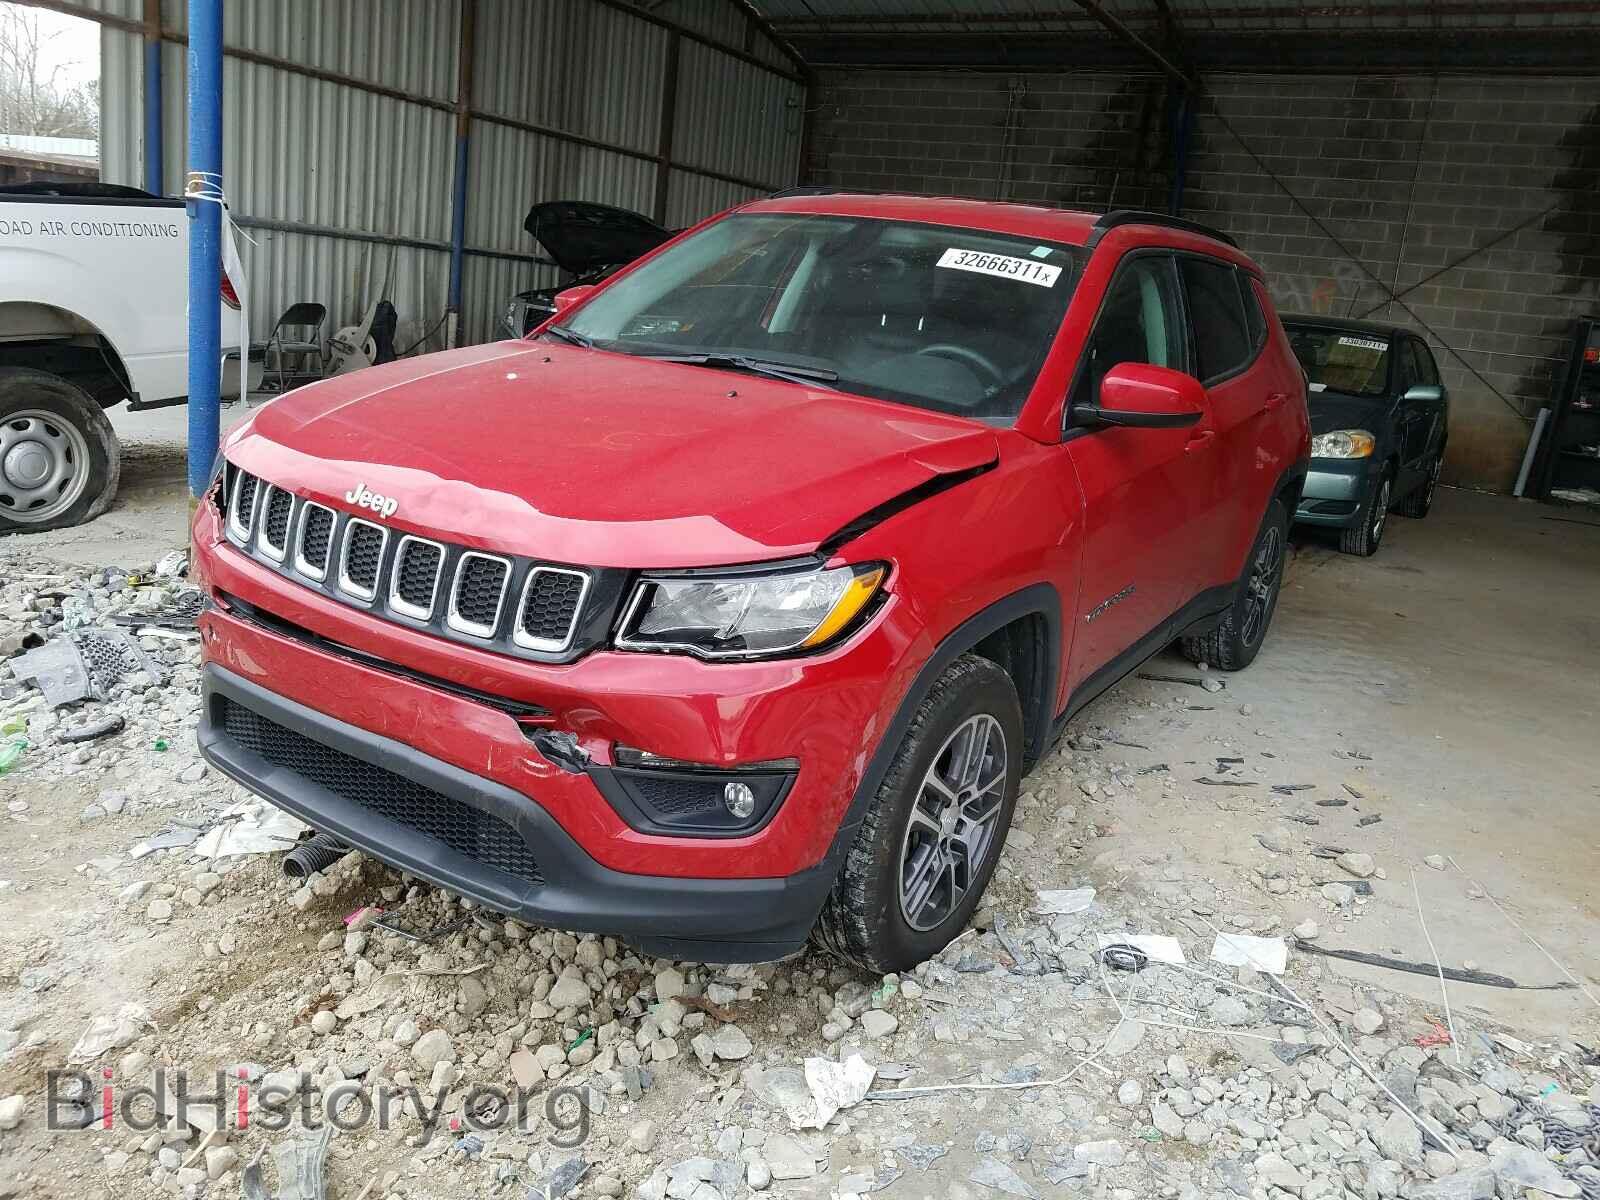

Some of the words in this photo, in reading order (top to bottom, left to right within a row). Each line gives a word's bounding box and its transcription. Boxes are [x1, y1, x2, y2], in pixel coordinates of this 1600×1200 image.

[40, 221, 67, 236] AIR
[71, 222, 179, 238] CONDITIONING
[345, 482, 399, 520] Jeep
